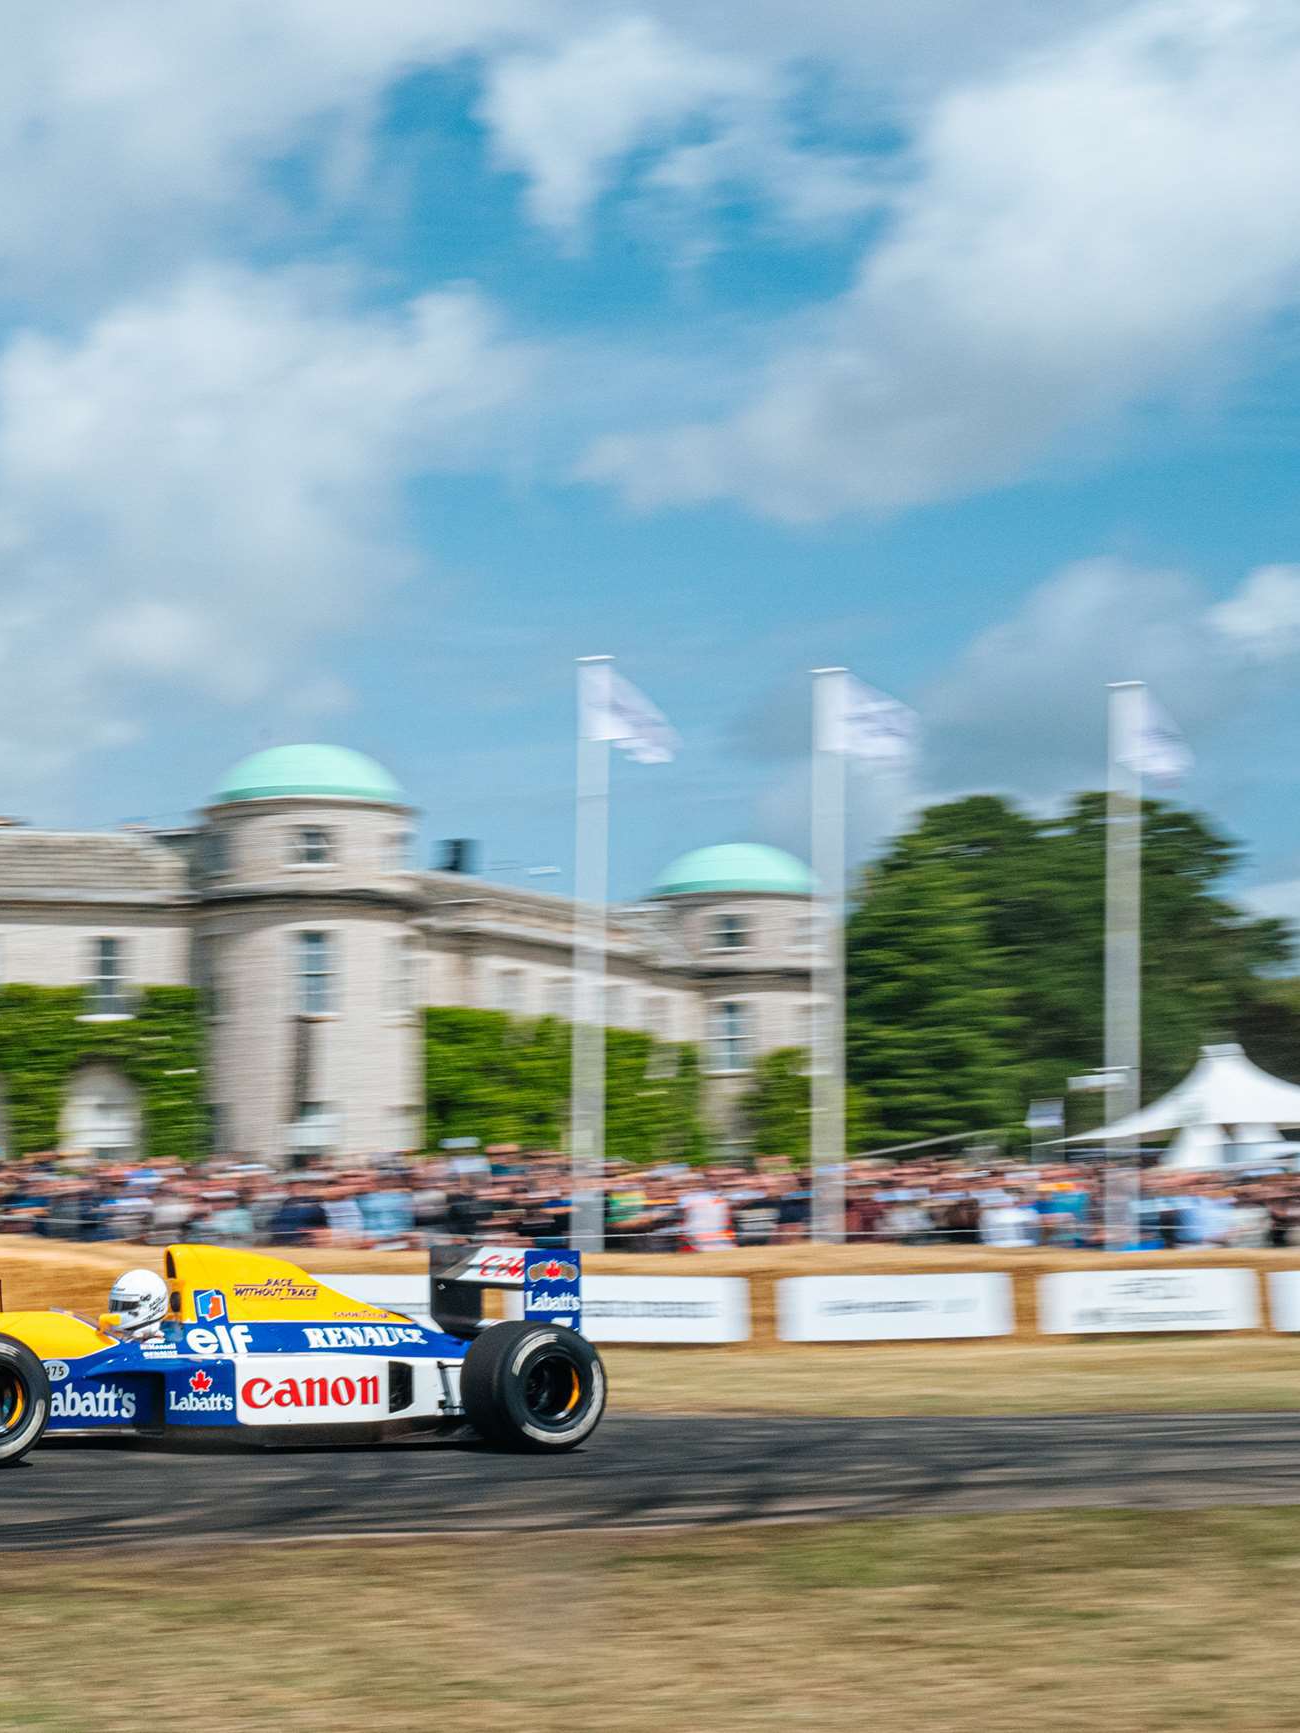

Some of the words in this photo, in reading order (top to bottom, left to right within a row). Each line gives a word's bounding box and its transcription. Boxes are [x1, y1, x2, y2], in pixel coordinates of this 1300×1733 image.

[233, 1287, 282, 1297] WITHOUT
[287, 1288, 317, 1297] TRACE
[265, 1278, 293, 1287] RACE
[525, 1290, 581, 1312] Labatt's
[186, 1324, 253, 1354] elf
[301, 1325, 429, 1349] RENAULT
[50, 1382, 137, 1418] abatt's
[169, 1390, 234, 1411] Labatt's
[241, 1375, 380, 1409] Canon
